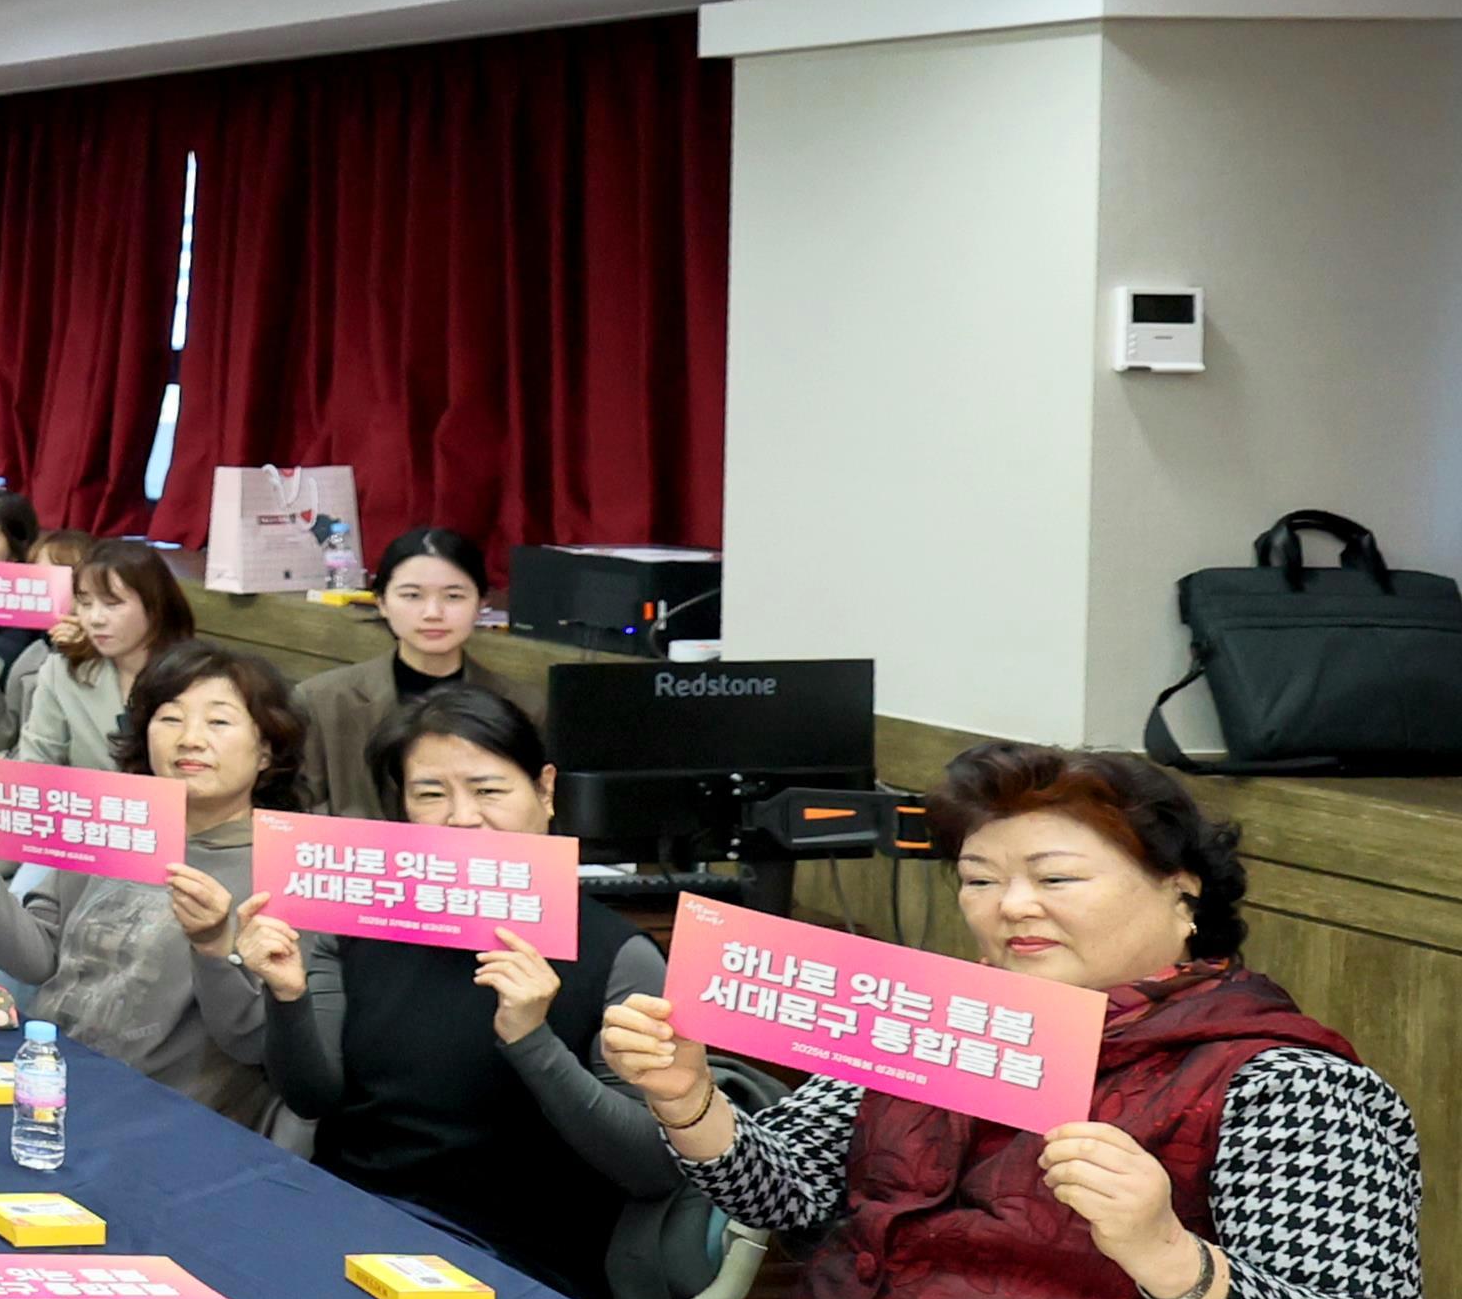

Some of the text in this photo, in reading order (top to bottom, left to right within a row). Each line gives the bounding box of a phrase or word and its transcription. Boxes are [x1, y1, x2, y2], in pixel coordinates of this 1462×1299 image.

[654, 672, 777, 698] Redstone
[46, 788, 93, 818] 잇는
[98, 796, 144, 825] 돌봄
[62, 817, 153, 853] 통합돌봄
[296, 841, 528, 890] 하나로 잇는 돌봄
[286, 869, 539, 923] 서대문구 통합돌봄
[721, 939, 1033, 1046] 하나로 잇는 돌봄
[700, 974, 1044, 1089] 서대문구 통합돌봄
